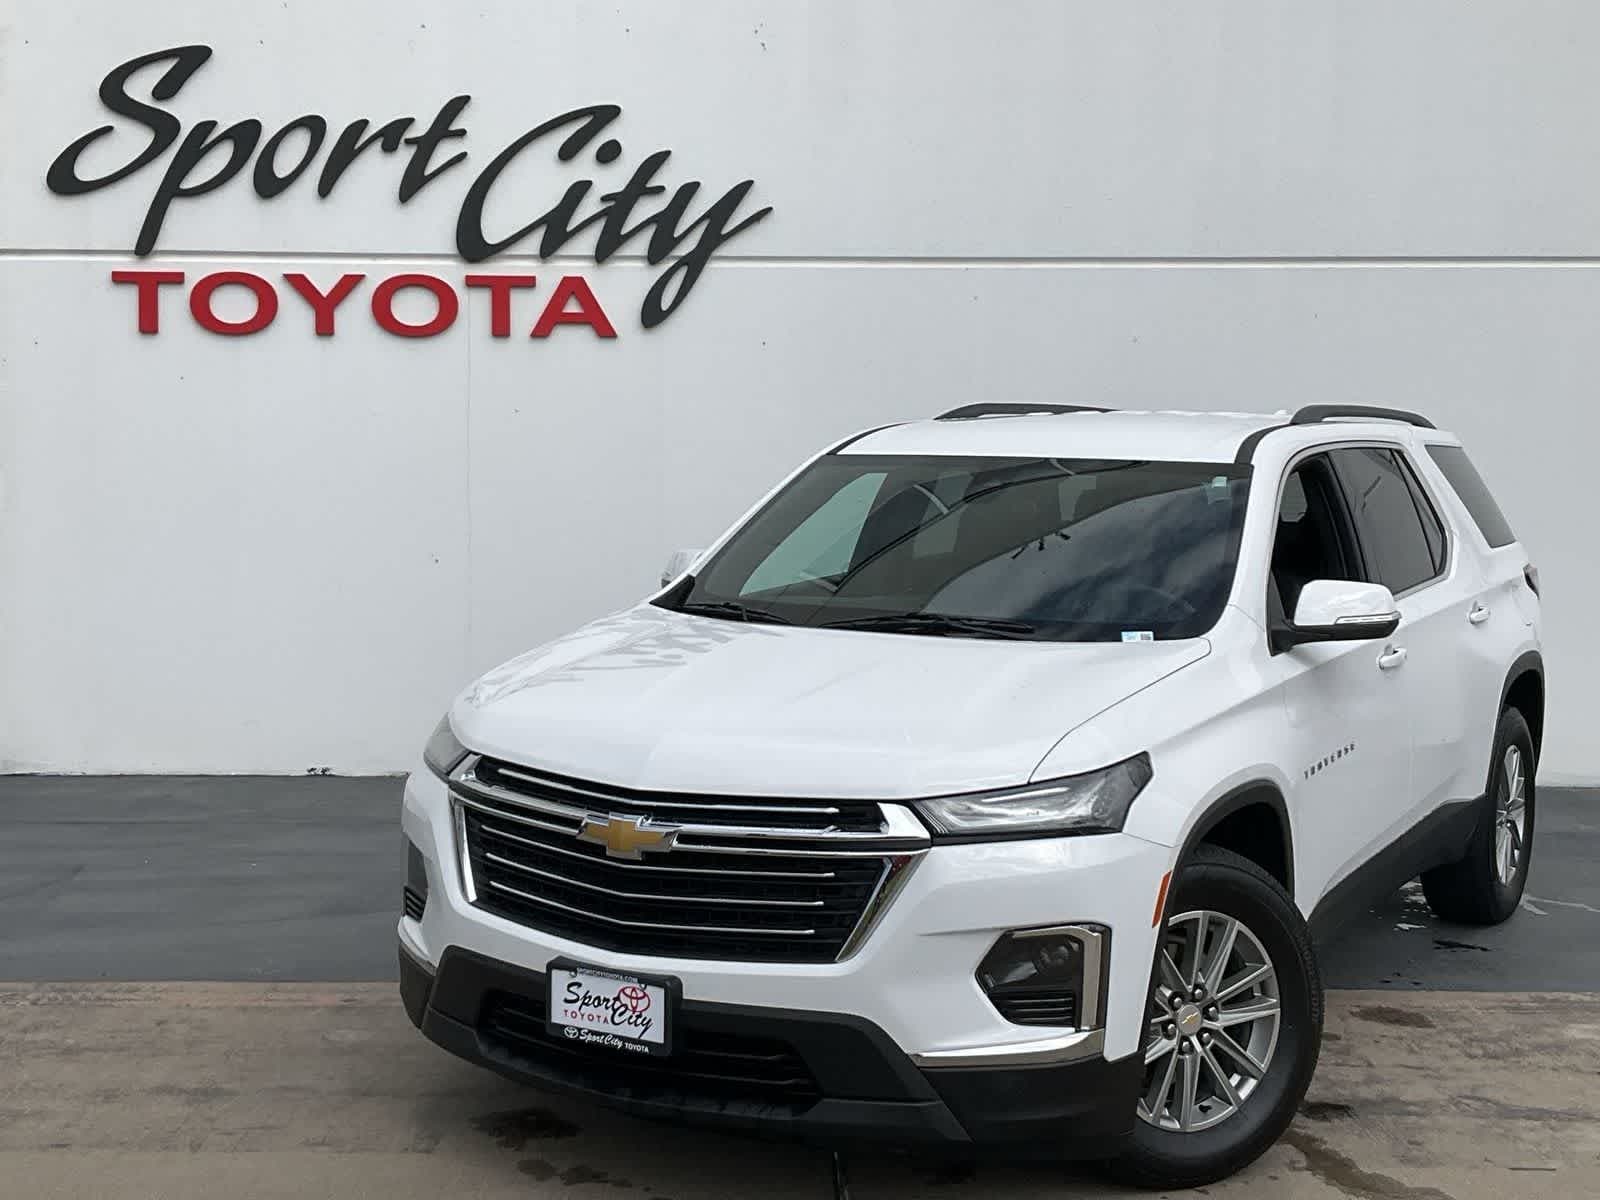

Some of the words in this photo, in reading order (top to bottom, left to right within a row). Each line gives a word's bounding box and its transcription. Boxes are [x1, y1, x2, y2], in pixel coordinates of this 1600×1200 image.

[46, 44, 472, 260] Sport
[455, 104, 774, 330] City
[111, 270, 618, 339] TOYOTA
[563, 981, 620, 1012] Sport
[610, 1004, 654, 1039] City
[563, 1009, 609, 1025] TOYOTA
[579, 1028, 605, 1043] Sport
[604, 1034, 623, 1050] City
[624, 1042, 649, 1053] TOYOTA
